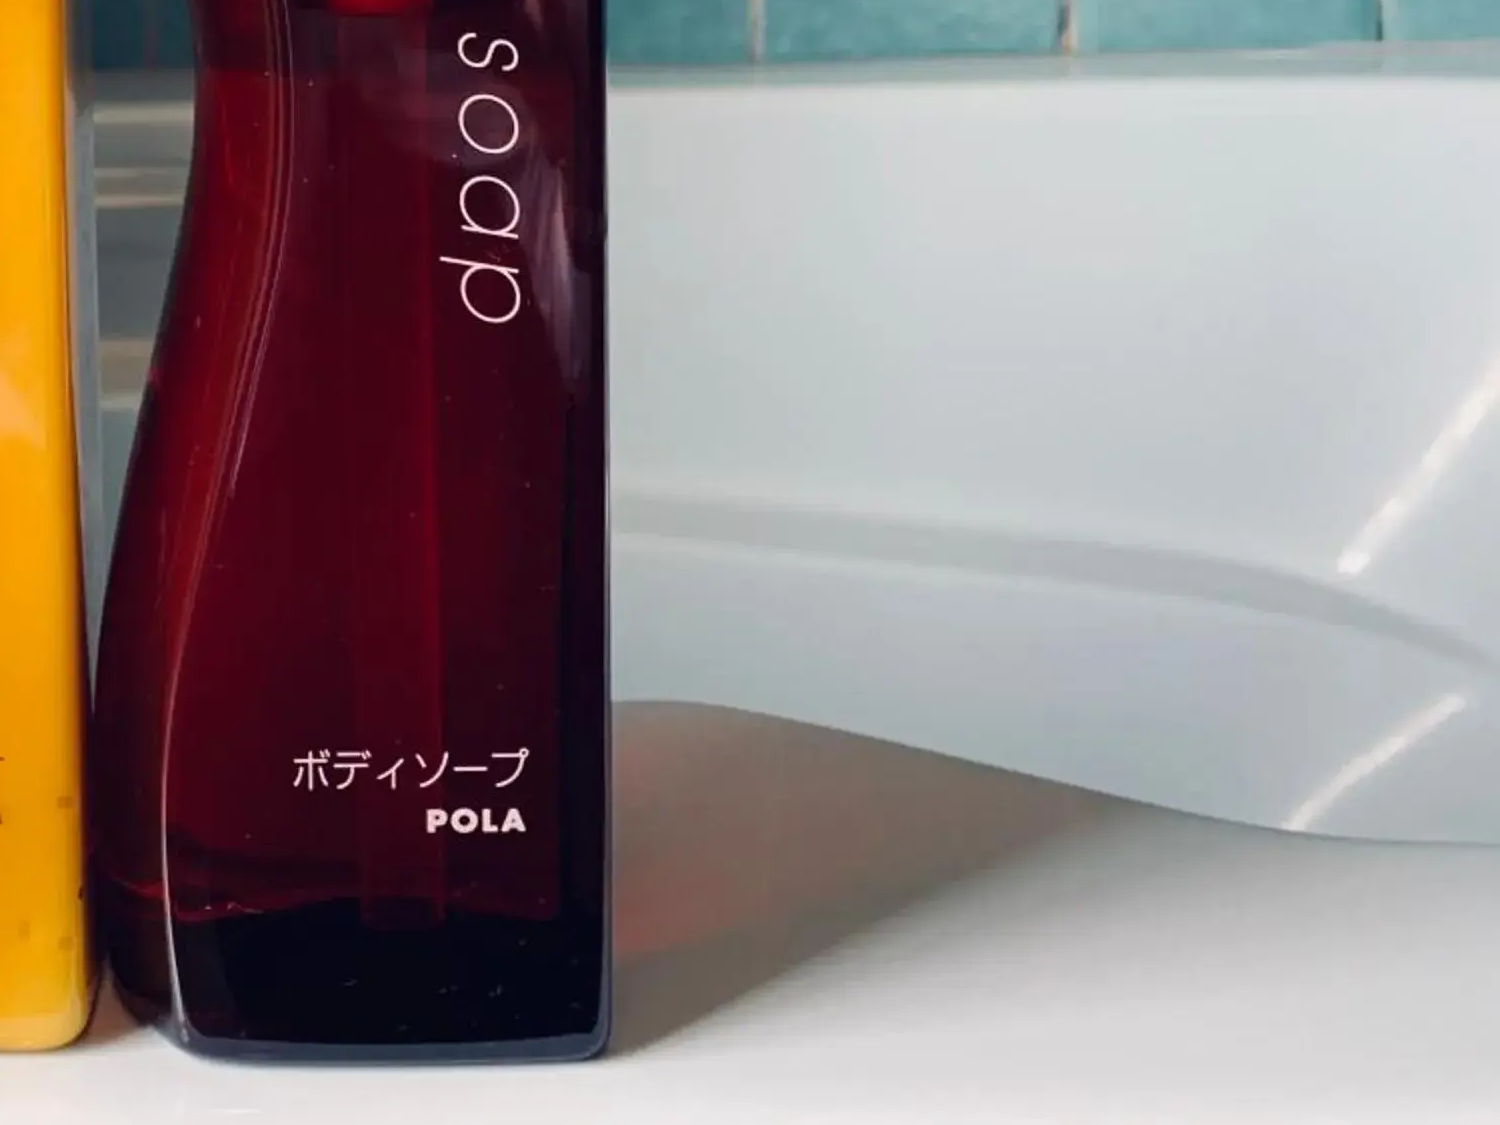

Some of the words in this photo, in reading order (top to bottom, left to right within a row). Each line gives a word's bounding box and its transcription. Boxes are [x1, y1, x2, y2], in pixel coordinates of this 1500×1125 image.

[439, 31, 522, 324] soap
[292, 747, 530, 792] ボディソープ
[425, 808, 527, 834] POLA
